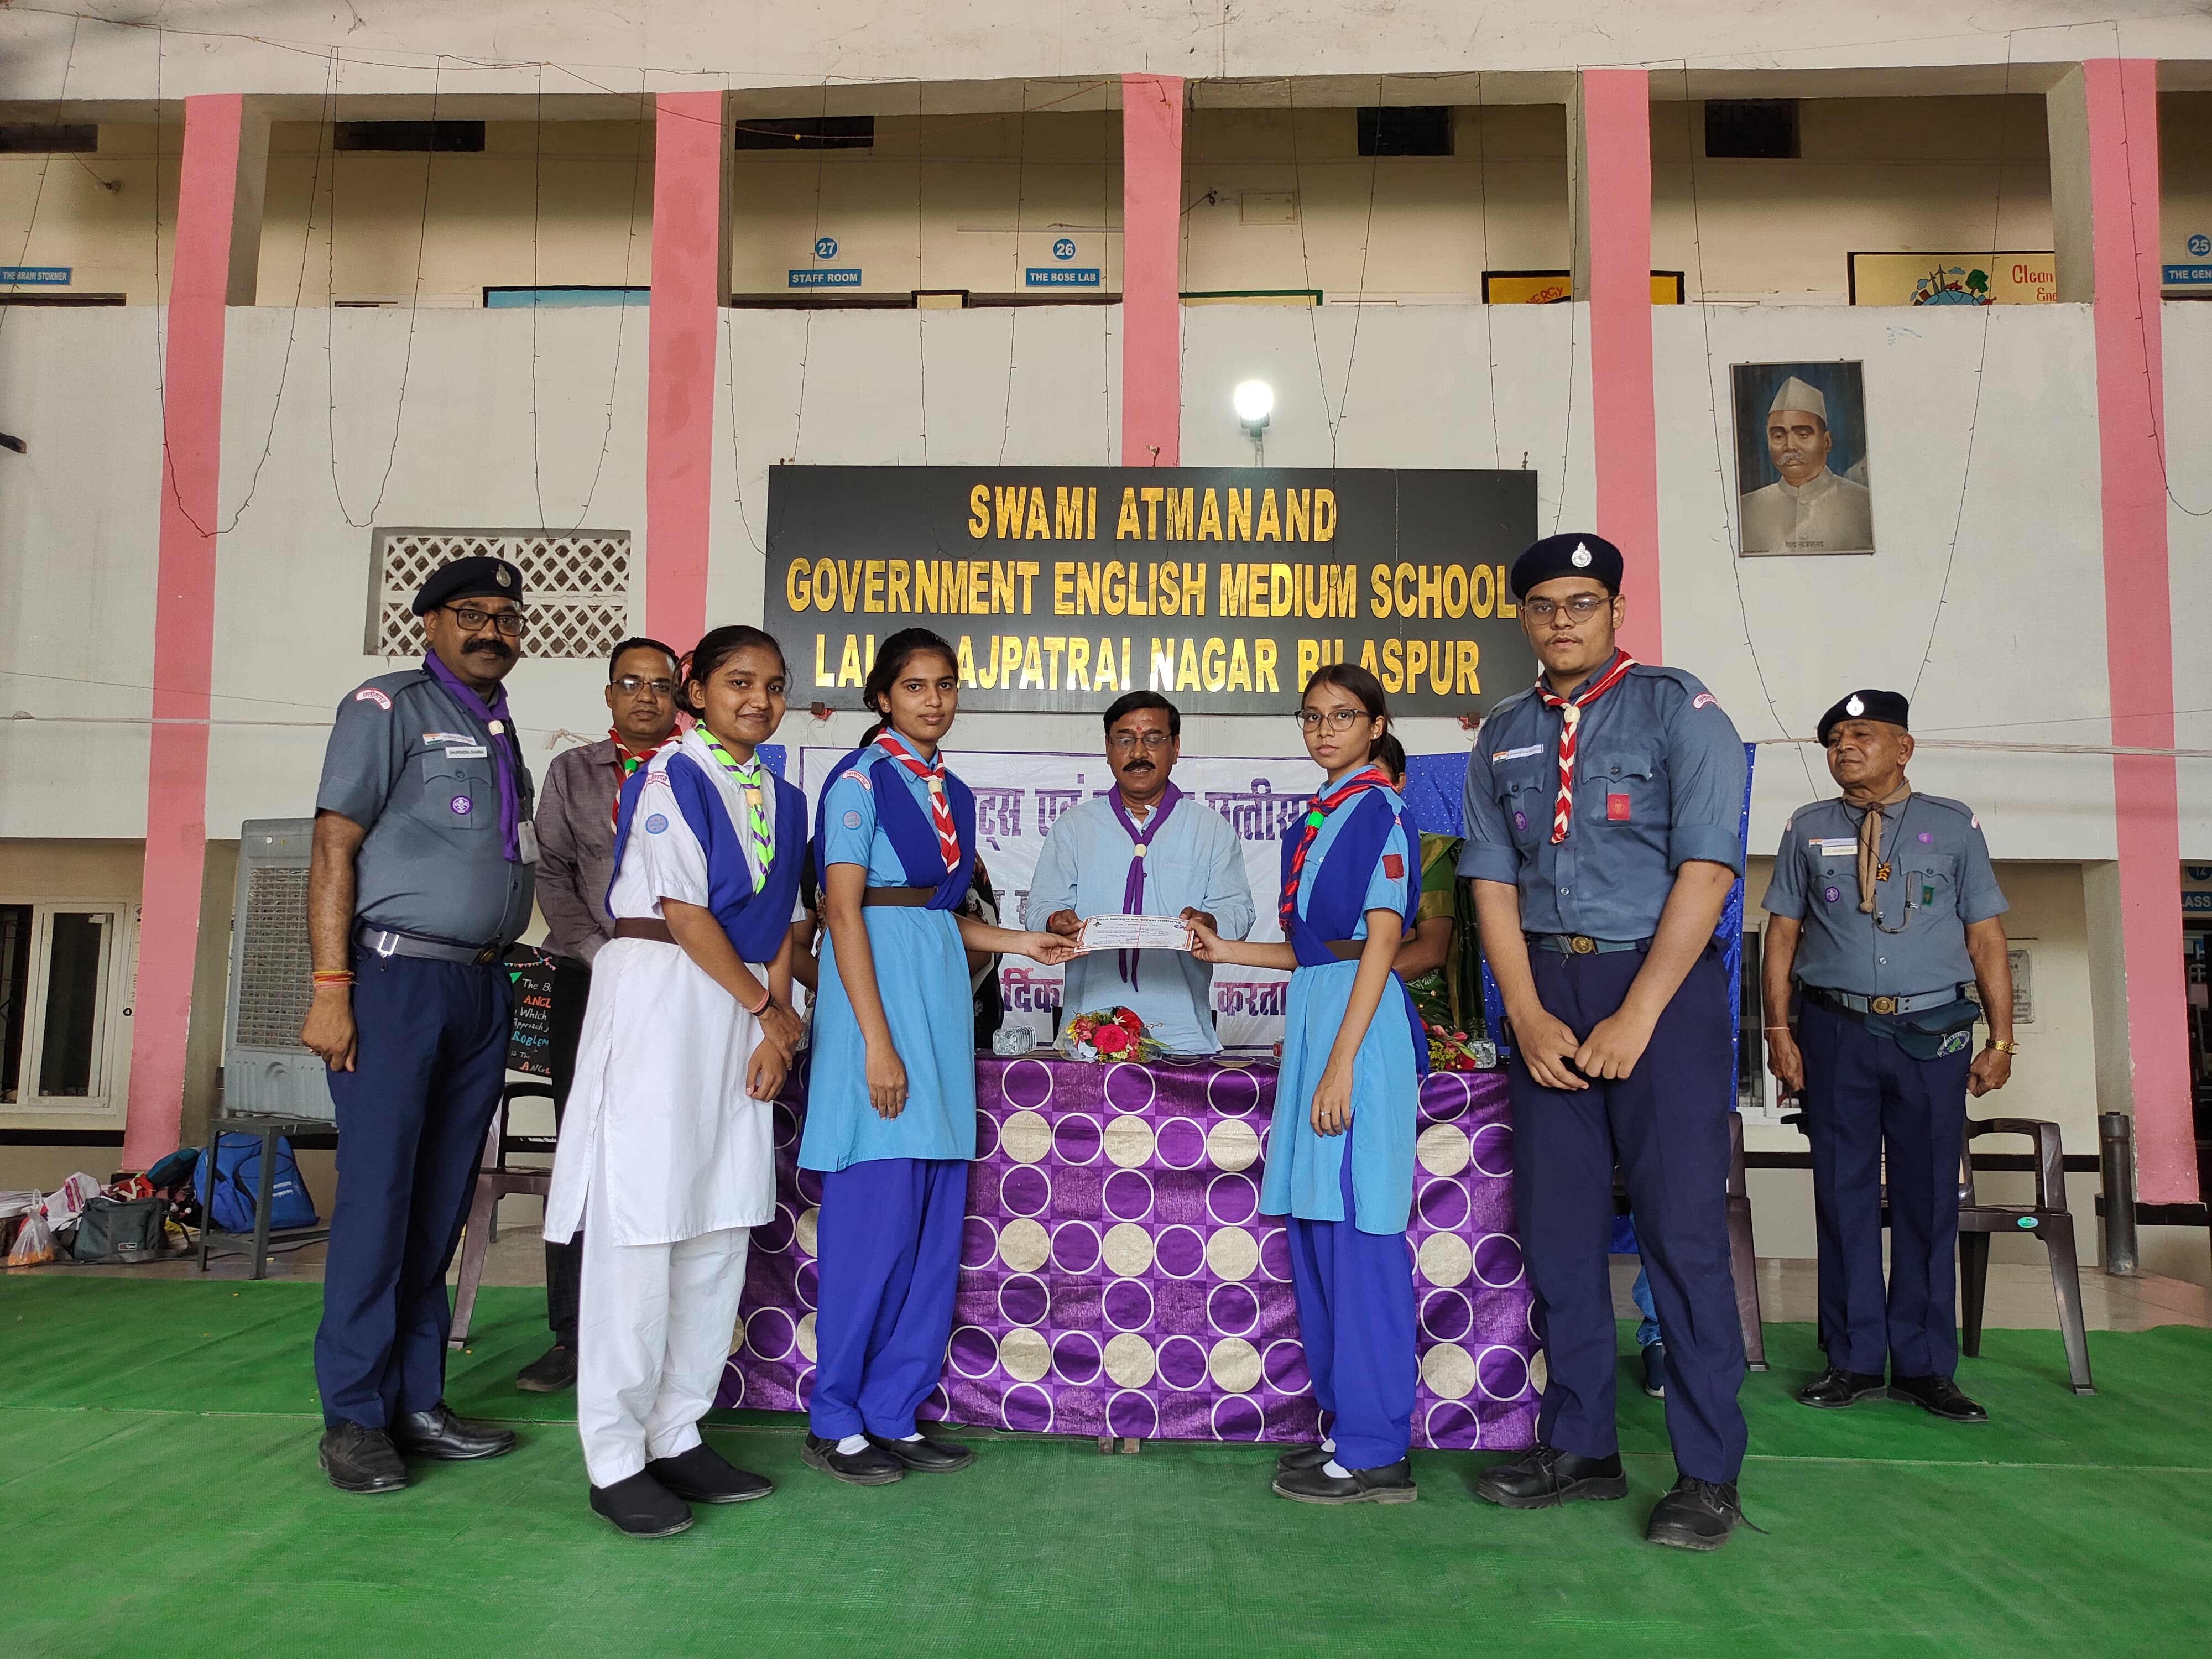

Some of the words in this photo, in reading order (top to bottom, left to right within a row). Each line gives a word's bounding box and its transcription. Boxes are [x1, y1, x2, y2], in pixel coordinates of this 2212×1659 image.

[818, 242, 835, 255] 27
[1056, 243, 1073, 256] 26
[2191, 239, 2209, 252] 25
[3, 271, 15, 280] THE
[17, 271, 36, 280] BRAIN
[37, 272, 67, 280] STORMER
[792, 274, 824, 283] STAFF
[827, 273, 858, 282] ROOM
[1030, 273, 1048, 281] THE
[1051, 273, 1076, 281] BOSE
[1078, 273, 1096, 281] LAB
[2012, 264, 2053, 284] Clean
[2168, 270, 2189, 279] THE
[968, 484, 1097, 540] SWAMI
[1115, 487, 1337, 542] ATMANAND
[786, 557, 1040, 615] GOVERNMENT
[1053, 560, 1207, 617] ENGLISH
[1219, 562, 1357, 619] MEDIUM
[1370, 562, 1518, 619] SCHOOL
[956, 634, 1131, 692] AJPATRAI
[1150, 637, 1281, 693] NAGAR
[2182, 895, 2211, 907] ASS
[523, 978, 539, 990] The
[520, 1006, 547, 1021] Which
[510, 1030, 549, 1047] ROBLEM
